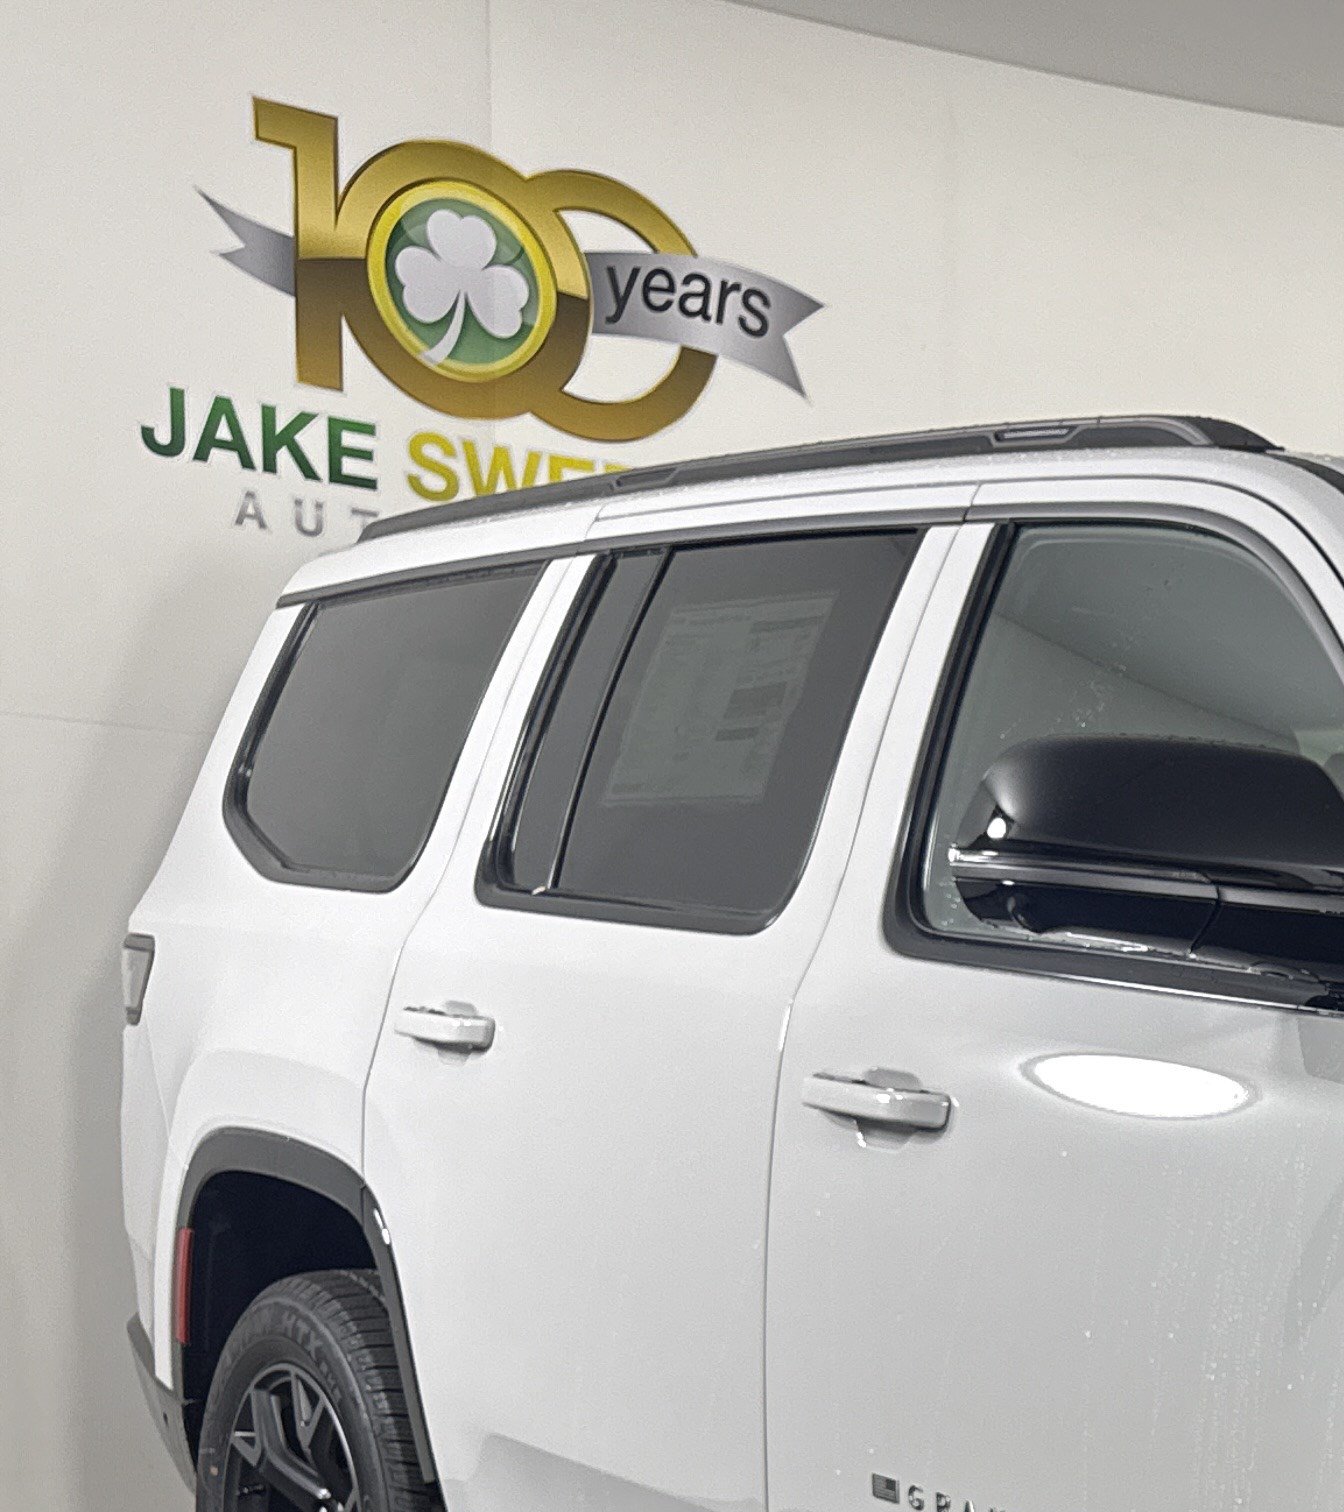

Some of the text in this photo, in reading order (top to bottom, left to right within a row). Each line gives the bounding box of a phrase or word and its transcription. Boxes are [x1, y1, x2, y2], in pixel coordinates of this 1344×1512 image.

[252, 95, 773, 442] 100 years
[141, 387, 378, 490] JAKE
